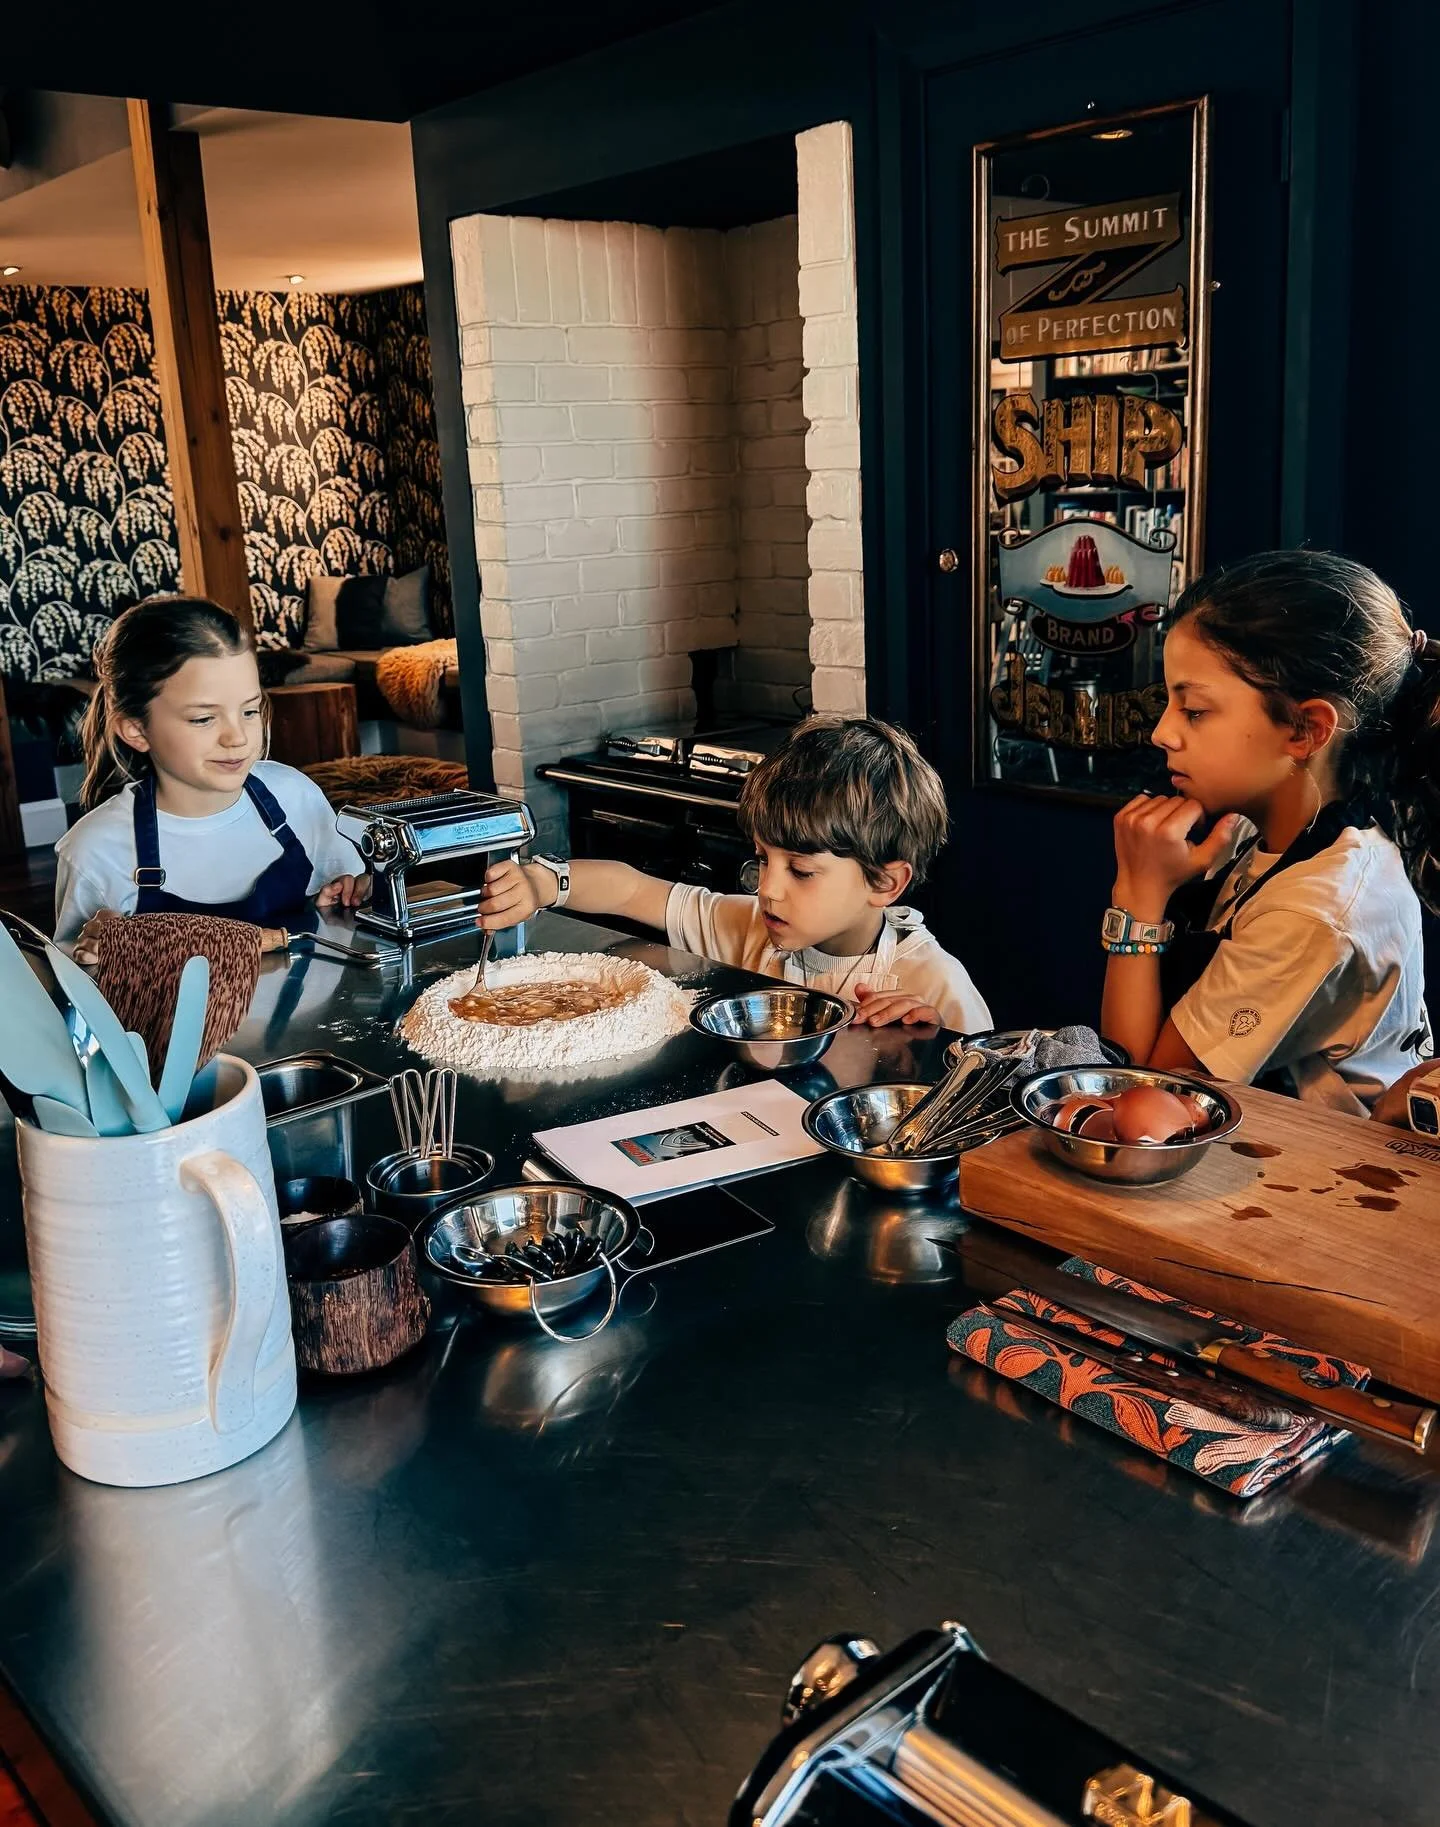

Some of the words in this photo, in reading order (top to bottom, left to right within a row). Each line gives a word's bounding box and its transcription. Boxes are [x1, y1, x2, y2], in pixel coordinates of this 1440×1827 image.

[1004, 227, 1049, 252] THE
[1064, 208, 1168, 243] SUMMIT
[1006, 324, 1031, 346] OF
[1037, 307, 1176, 342] PERFECTION
[991, 392, 1185, 508] SHIP
[1046, 620, 1116, 646] BRAND
